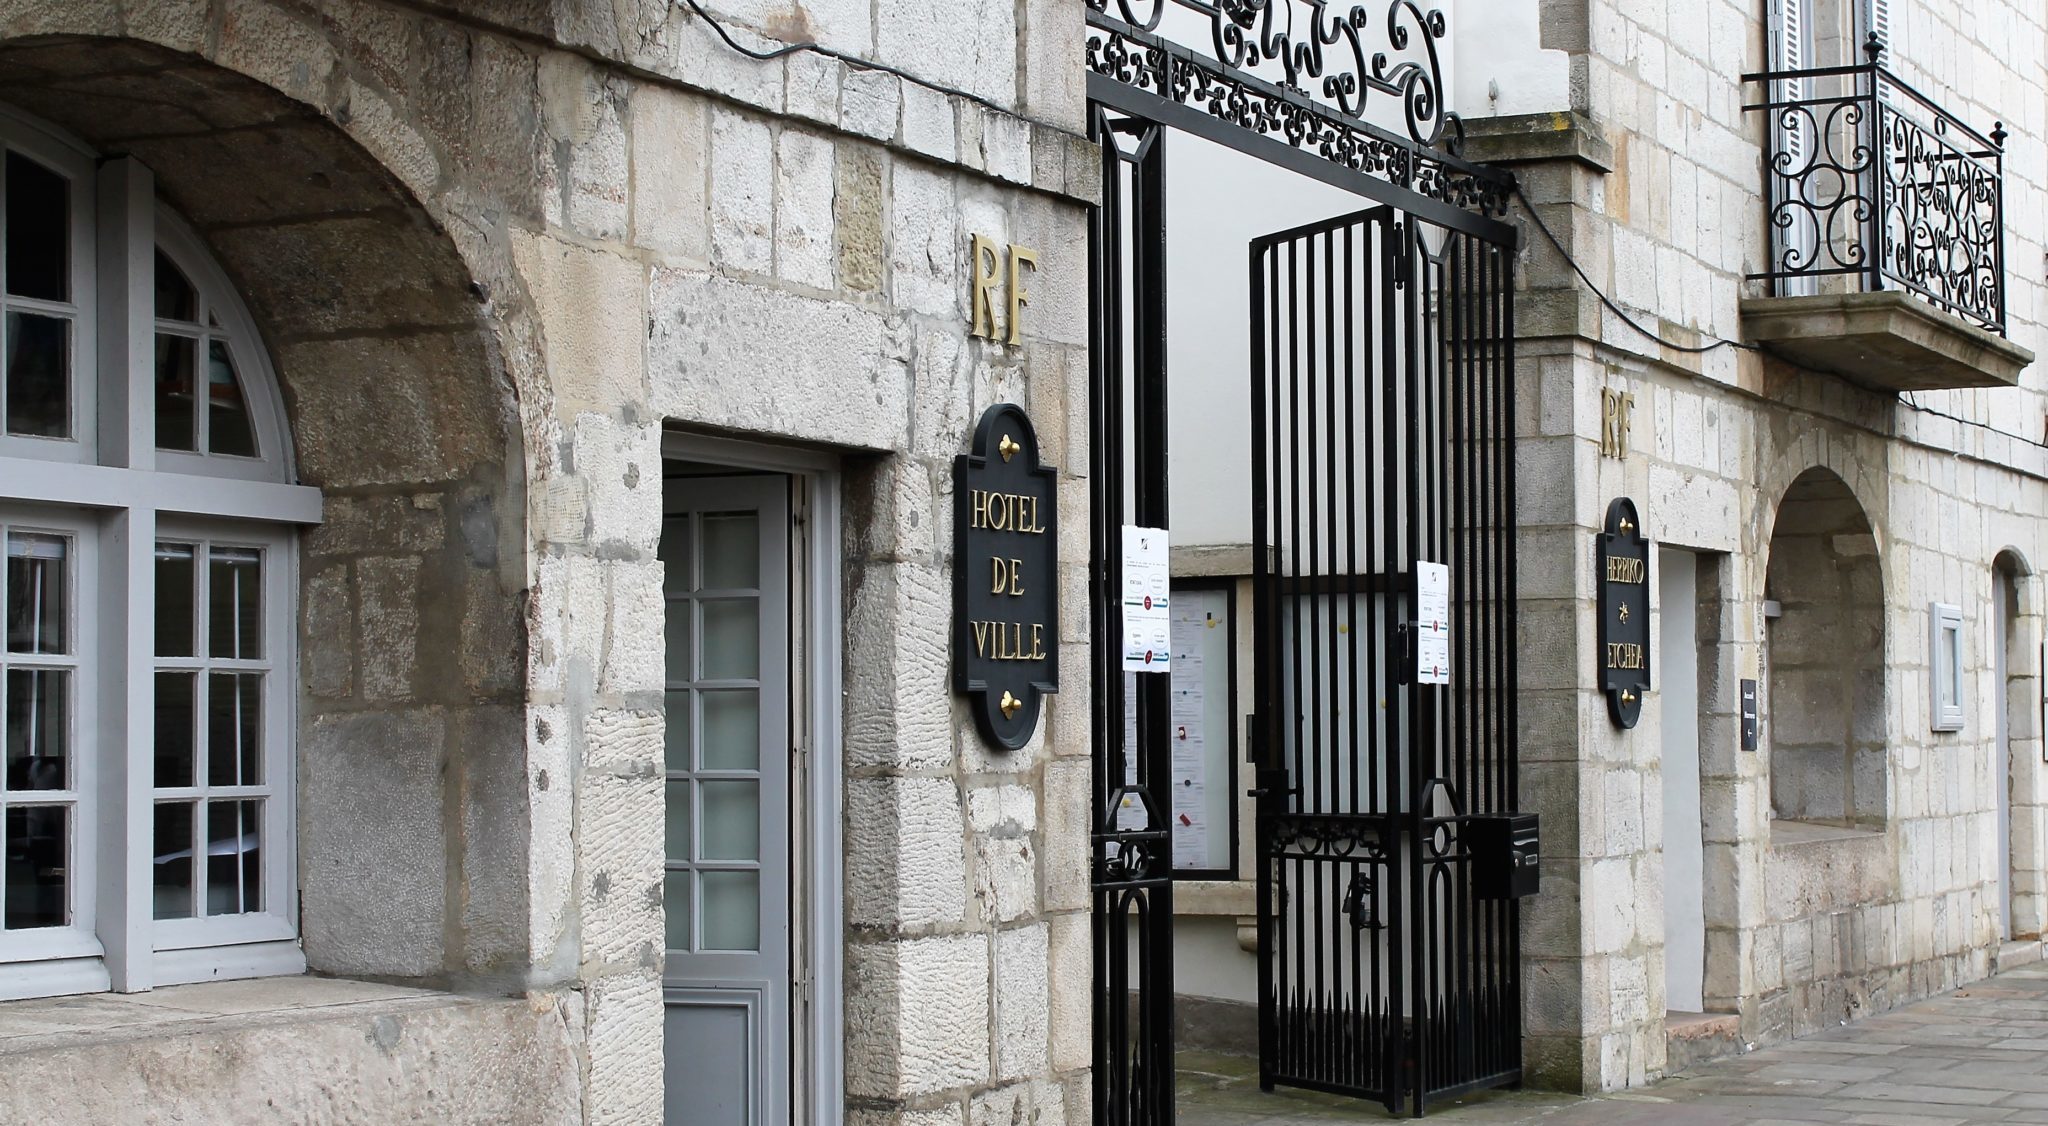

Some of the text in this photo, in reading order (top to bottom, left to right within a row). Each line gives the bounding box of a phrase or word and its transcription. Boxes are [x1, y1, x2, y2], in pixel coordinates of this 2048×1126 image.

[970, 233, 1039, 346] RF
[1601, 386, 1635, 460] RF
[971, 489, 1046, 534] HOTEL
[991, 556, 1025, 596] DE
[970, 620, 1047, 660] VILLE
[1607, 642, 1645, 669] ETCHEA
